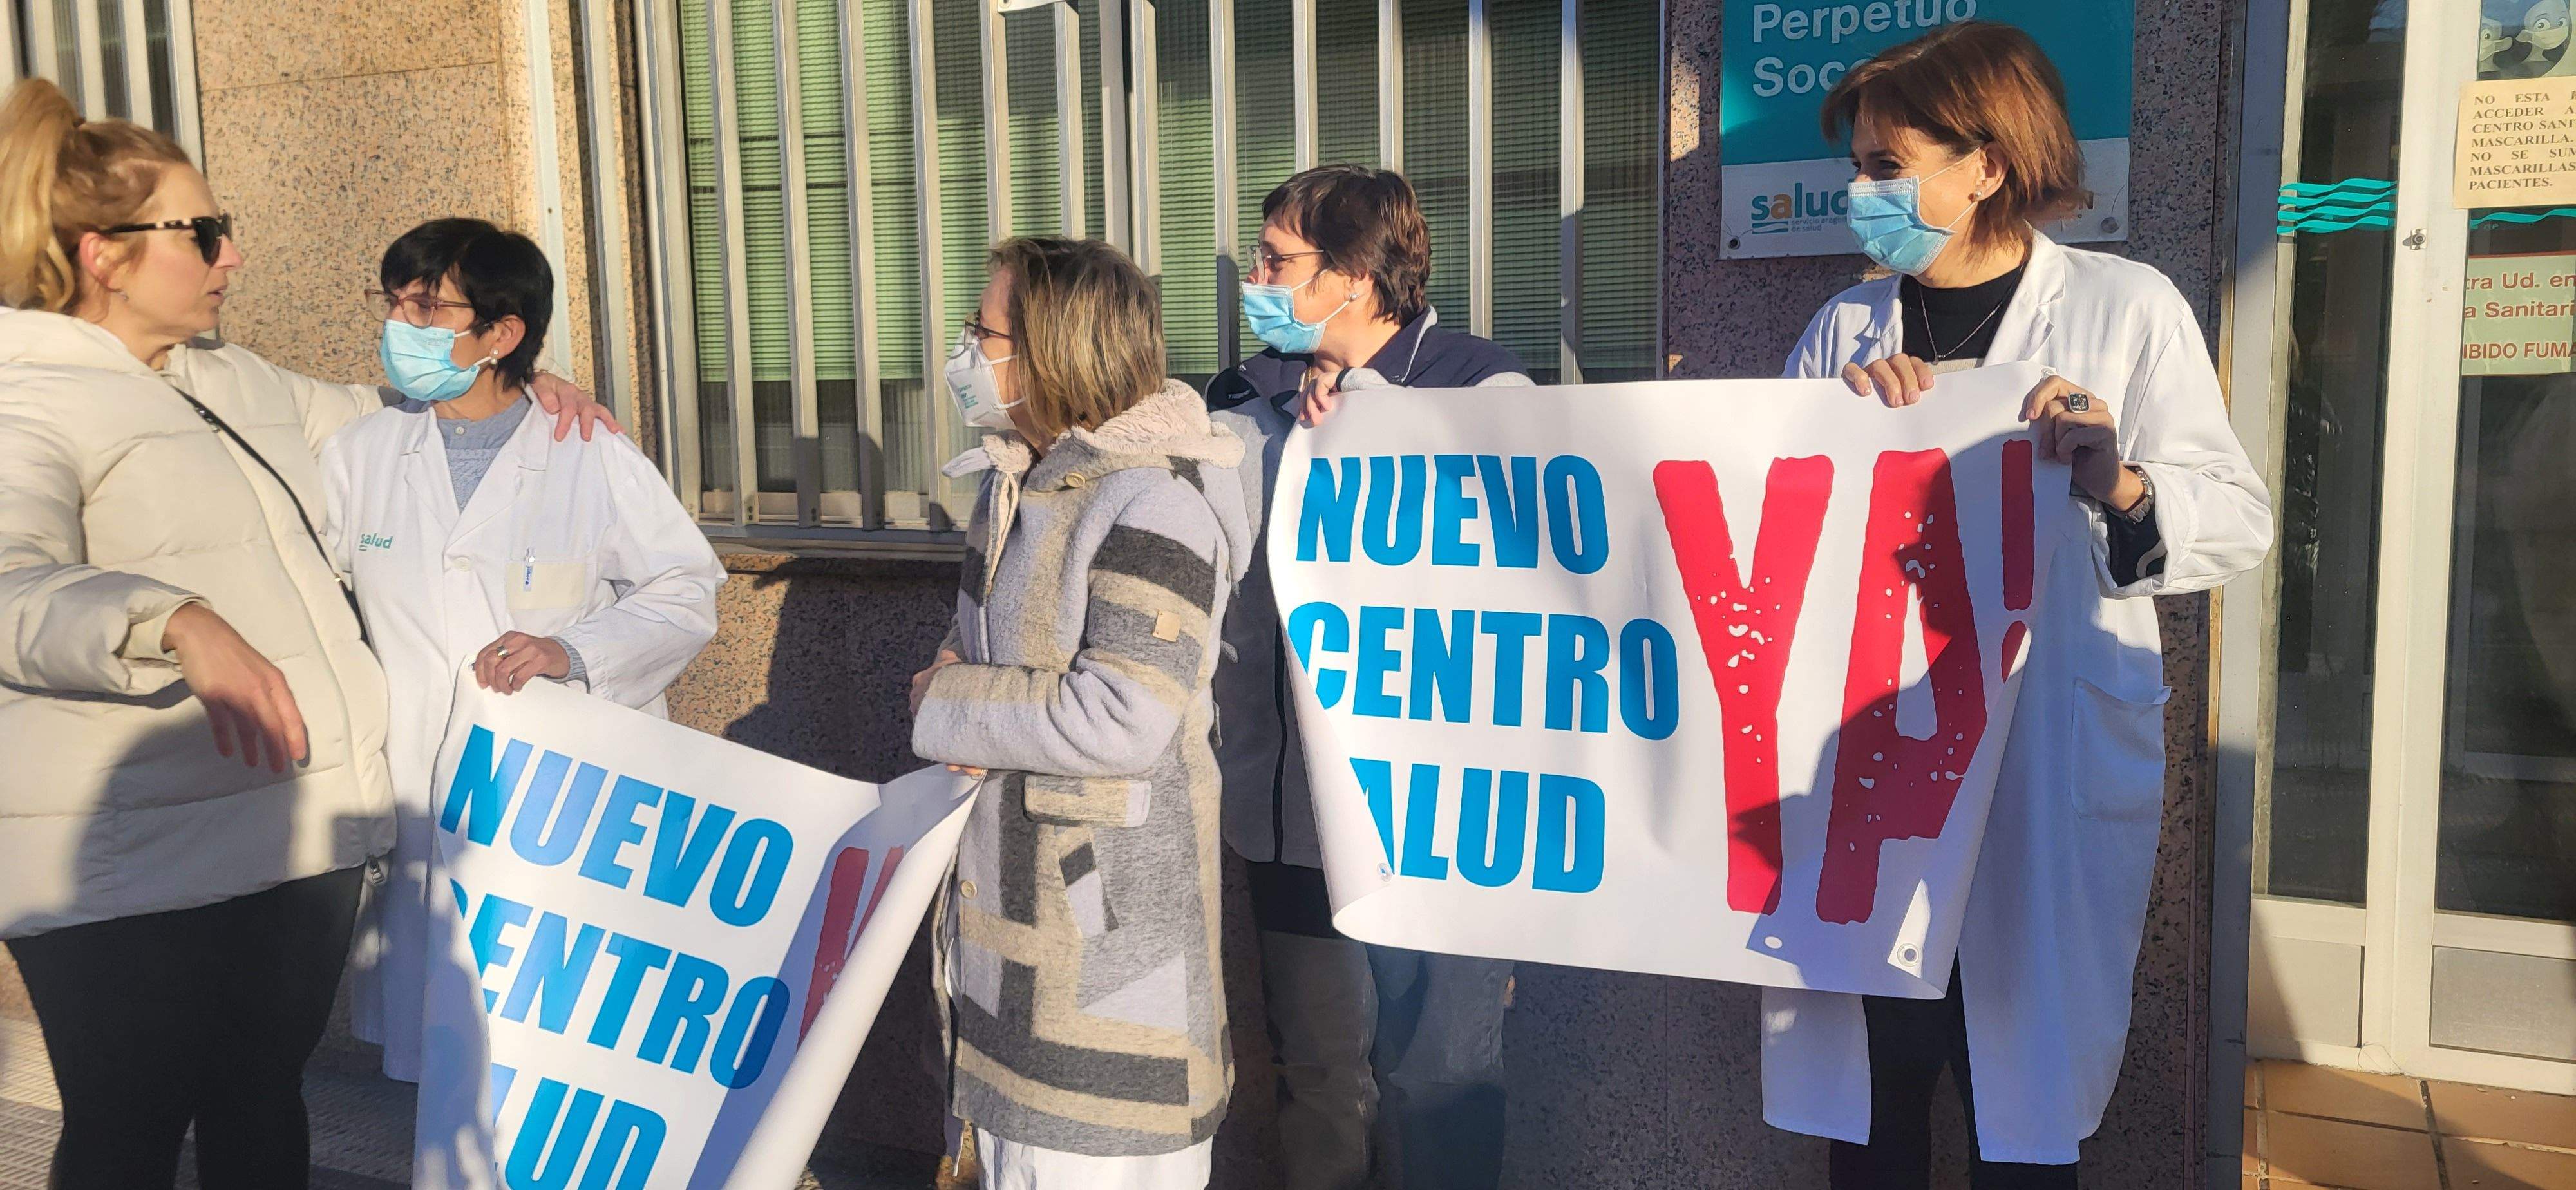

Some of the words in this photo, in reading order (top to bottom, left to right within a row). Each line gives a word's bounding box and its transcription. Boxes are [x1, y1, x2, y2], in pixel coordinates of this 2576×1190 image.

[1753, 0, 1976, 44] Perpetuo
[1752, 56, 1873, 97] Soc
[2474, 95, 2496, 105] NO
[2515, 92, 2551, 103] ESTA
[2472, 106, 2544, 120] ACCEDER
[2472, 120, 2534, 134] CENTRO
[2539, 118, 2576, 130] SANI
[2471, 133, 2574, 148] MASCARILLA.
[2470, 151, 2492, 162] NO
[2511, 149, 2530, 160] SE
[2469, 161, 2576, 176] MASCARILLAS
[2468, 176, 2553, 191] PACIENTES.
[2502, 272, 2541, 289] Ud.
[2550, 274, 2576, 288] en
[1296, 454, 1609, 576] NUEVO
[360, 533, 393, 549] salud
[1288, 601, 1680, 741] CENTRO
[1653, 439, 2034, 924] YA!
[439, 724, 794, 928] NUEVO
[450, 878, 790, 1090] ENTRO
